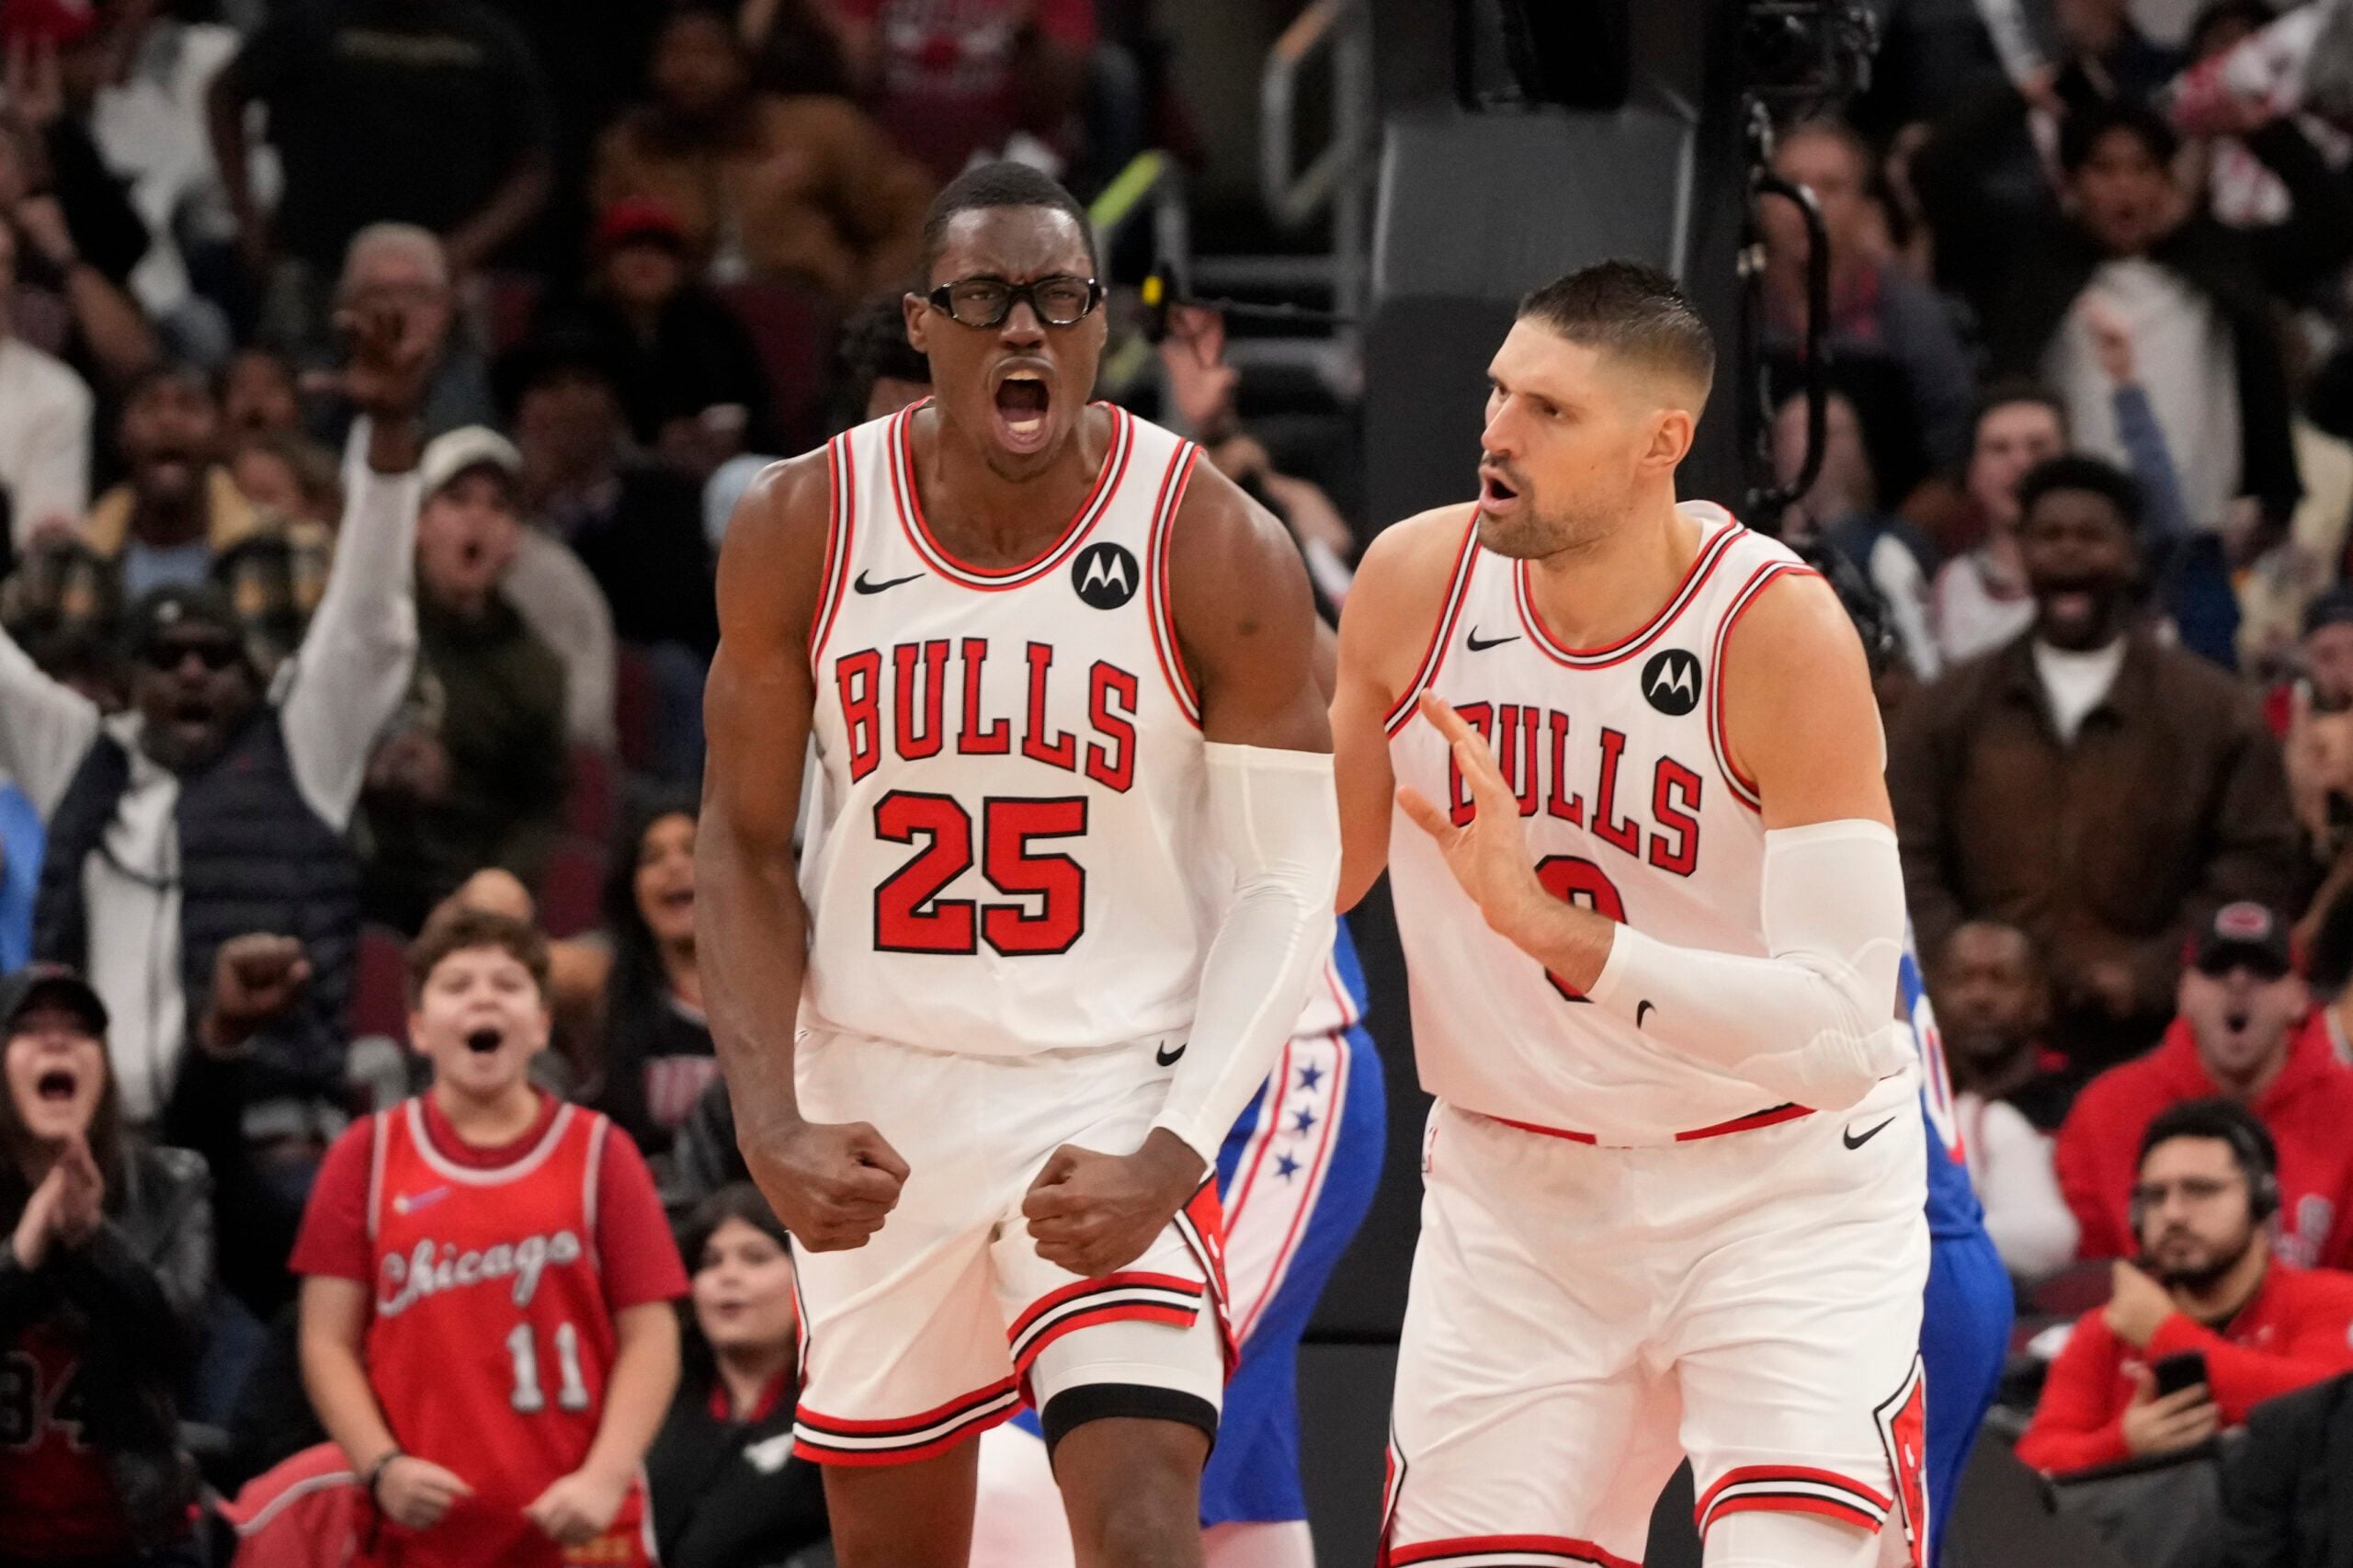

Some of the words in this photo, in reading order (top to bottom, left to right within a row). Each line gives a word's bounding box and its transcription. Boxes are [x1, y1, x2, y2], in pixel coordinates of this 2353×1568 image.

[835, 636, 1139, 794] BULLS
[872, 789, 1088, 958] 25
[376, 1229, 581, 1318] Chicago
[506, 1319, 591, 1415] 11
